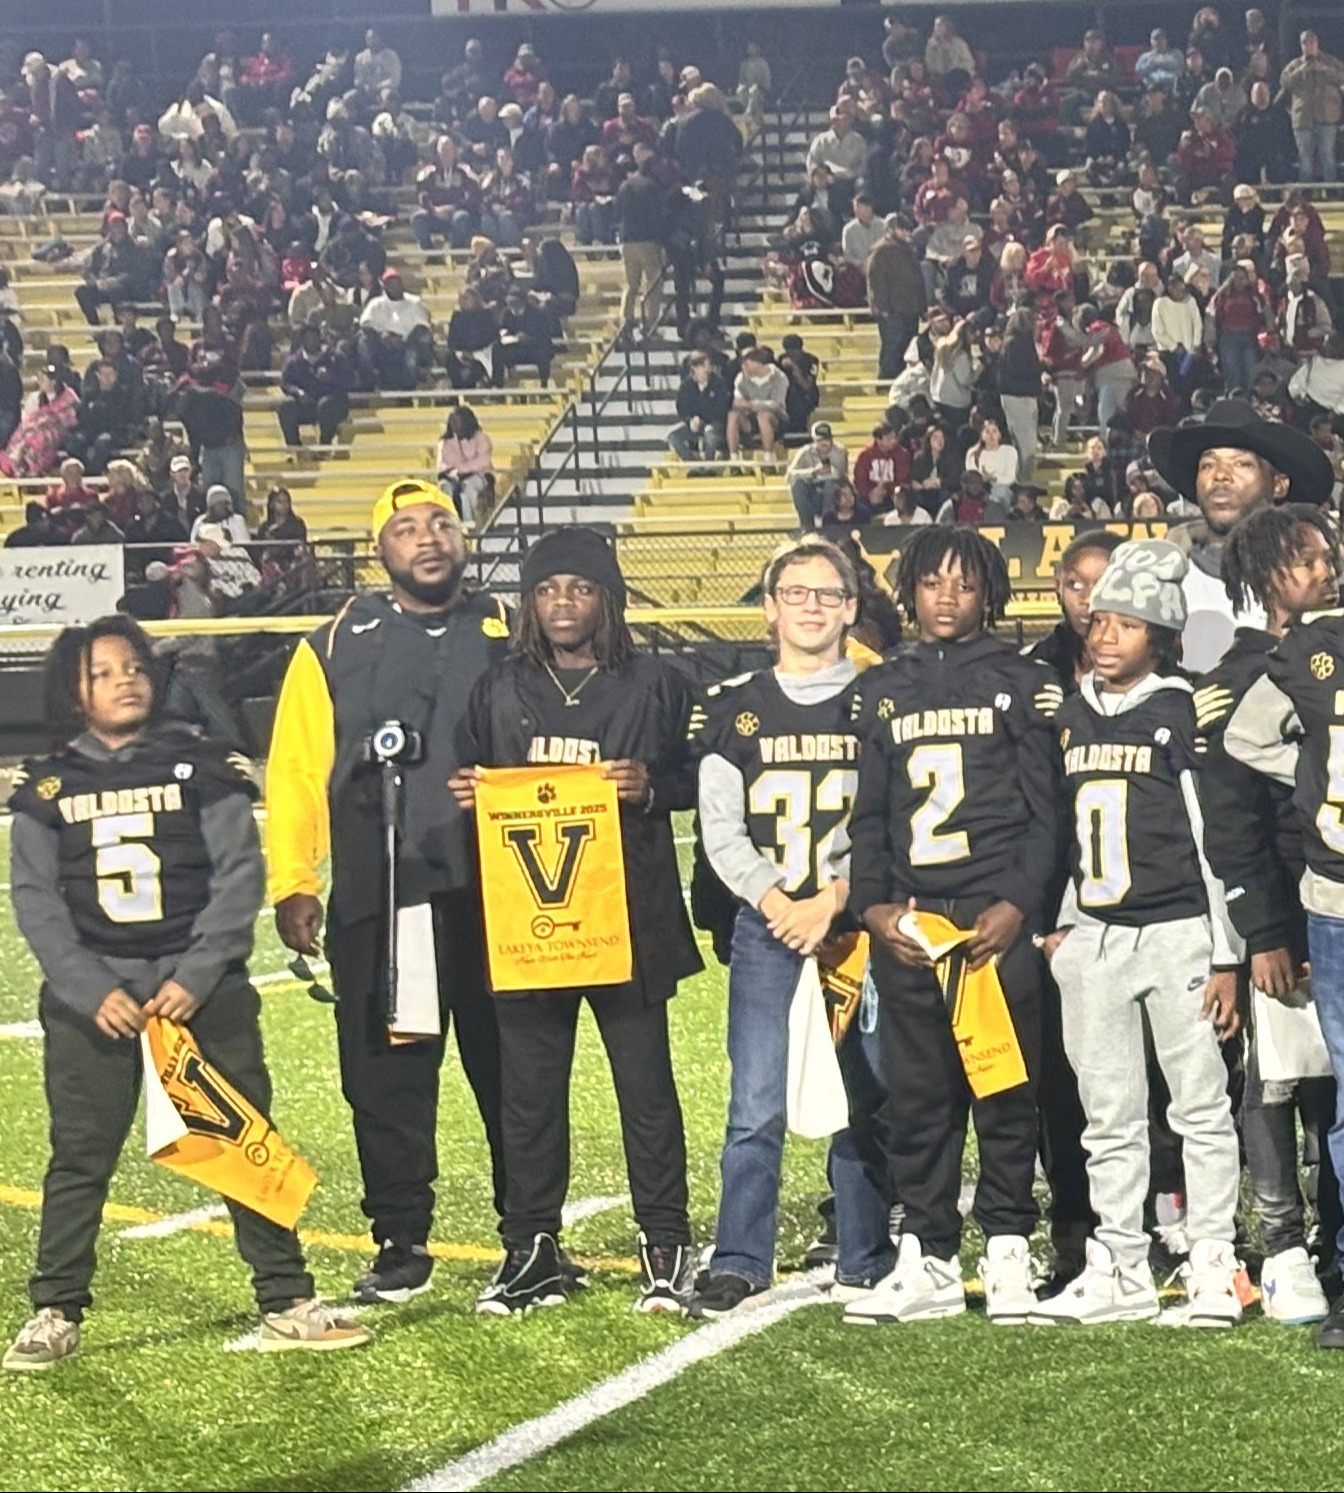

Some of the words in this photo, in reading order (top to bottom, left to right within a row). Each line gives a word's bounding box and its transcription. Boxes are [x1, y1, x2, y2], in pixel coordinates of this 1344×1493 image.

[15, 559, 110, 581] renting
[0, 588, 66, 615] ying
[891, 707, 994, 744] VALDOSTA
[758, 734, 861, 763] VALDOST
[58, 783, 183, 825] VALDOSTA
[906, 742, 972, 867] 2
[1075, 778, 1132, 907] 0
[92, 812, 164, 923] 5
[501, 818, 597, 911] V
